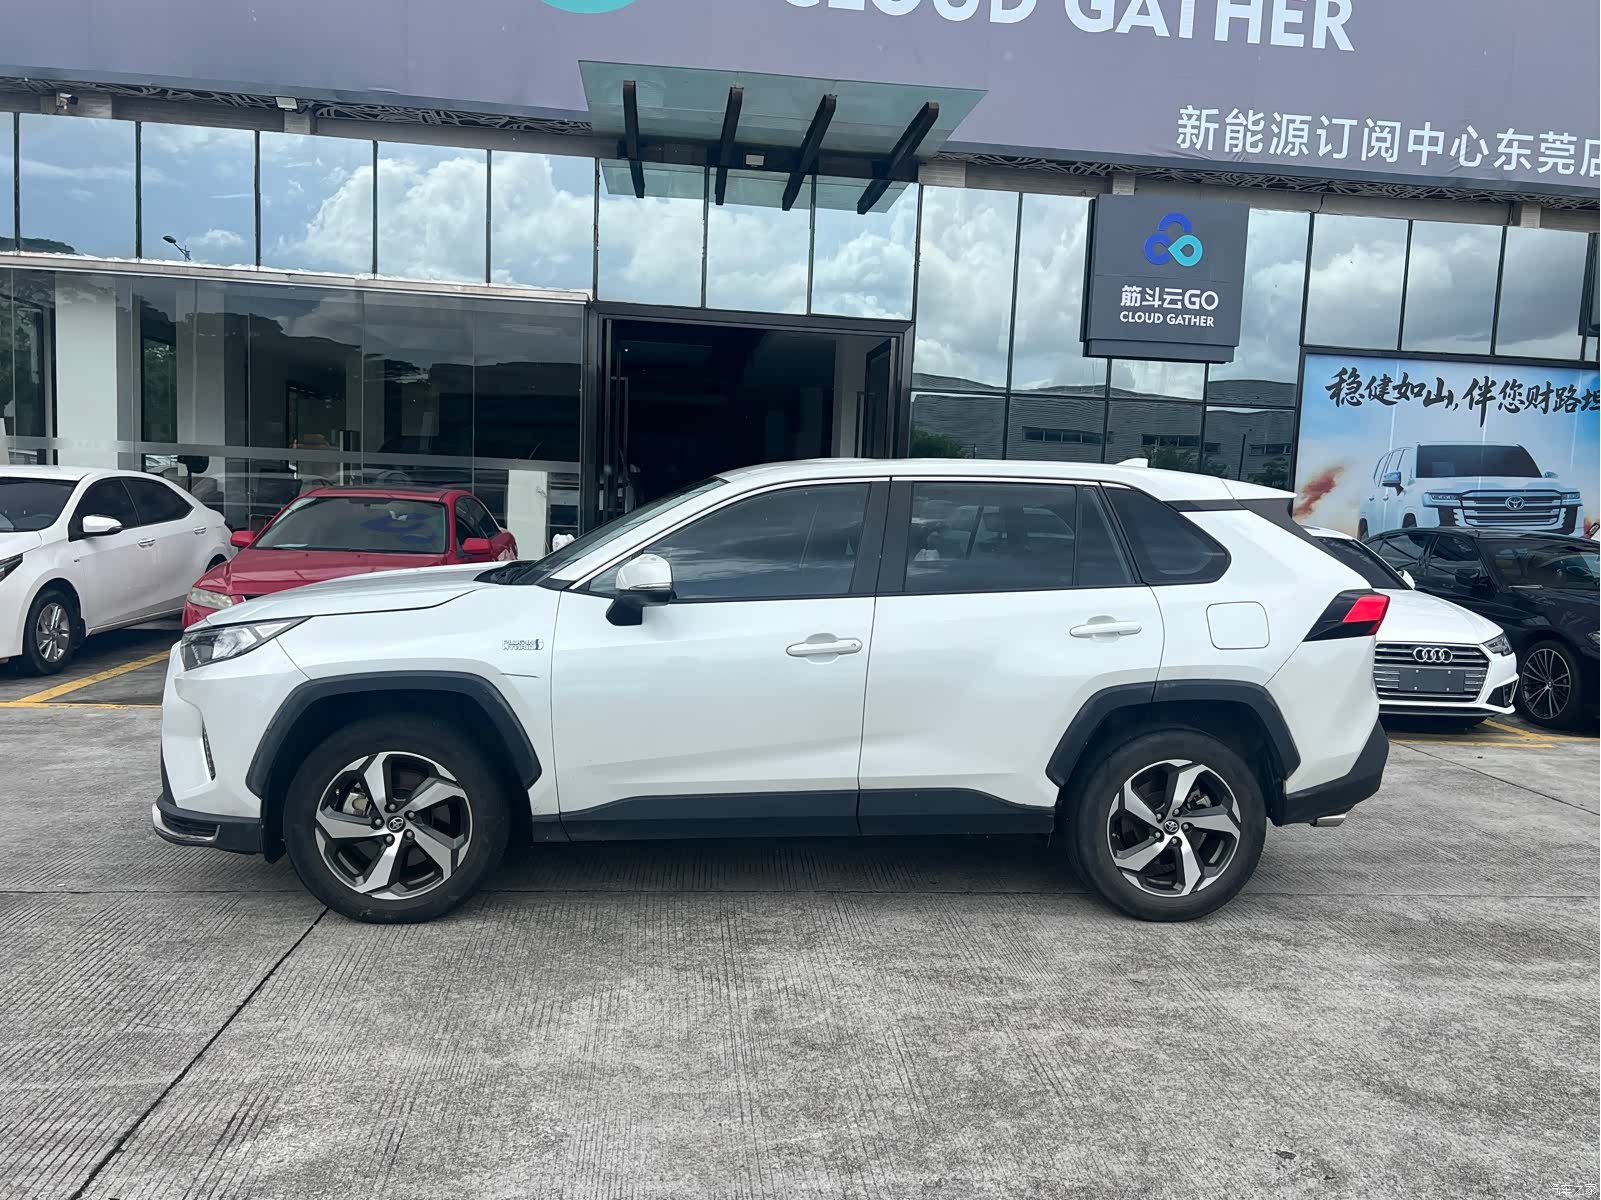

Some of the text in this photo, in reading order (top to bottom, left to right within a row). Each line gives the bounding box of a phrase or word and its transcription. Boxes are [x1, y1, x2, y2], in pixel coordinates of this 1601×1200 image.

[1120, 285, 1219, 310] 筋斗云GO
[1119, 311, 1215, 327] CLOUD GATHER
